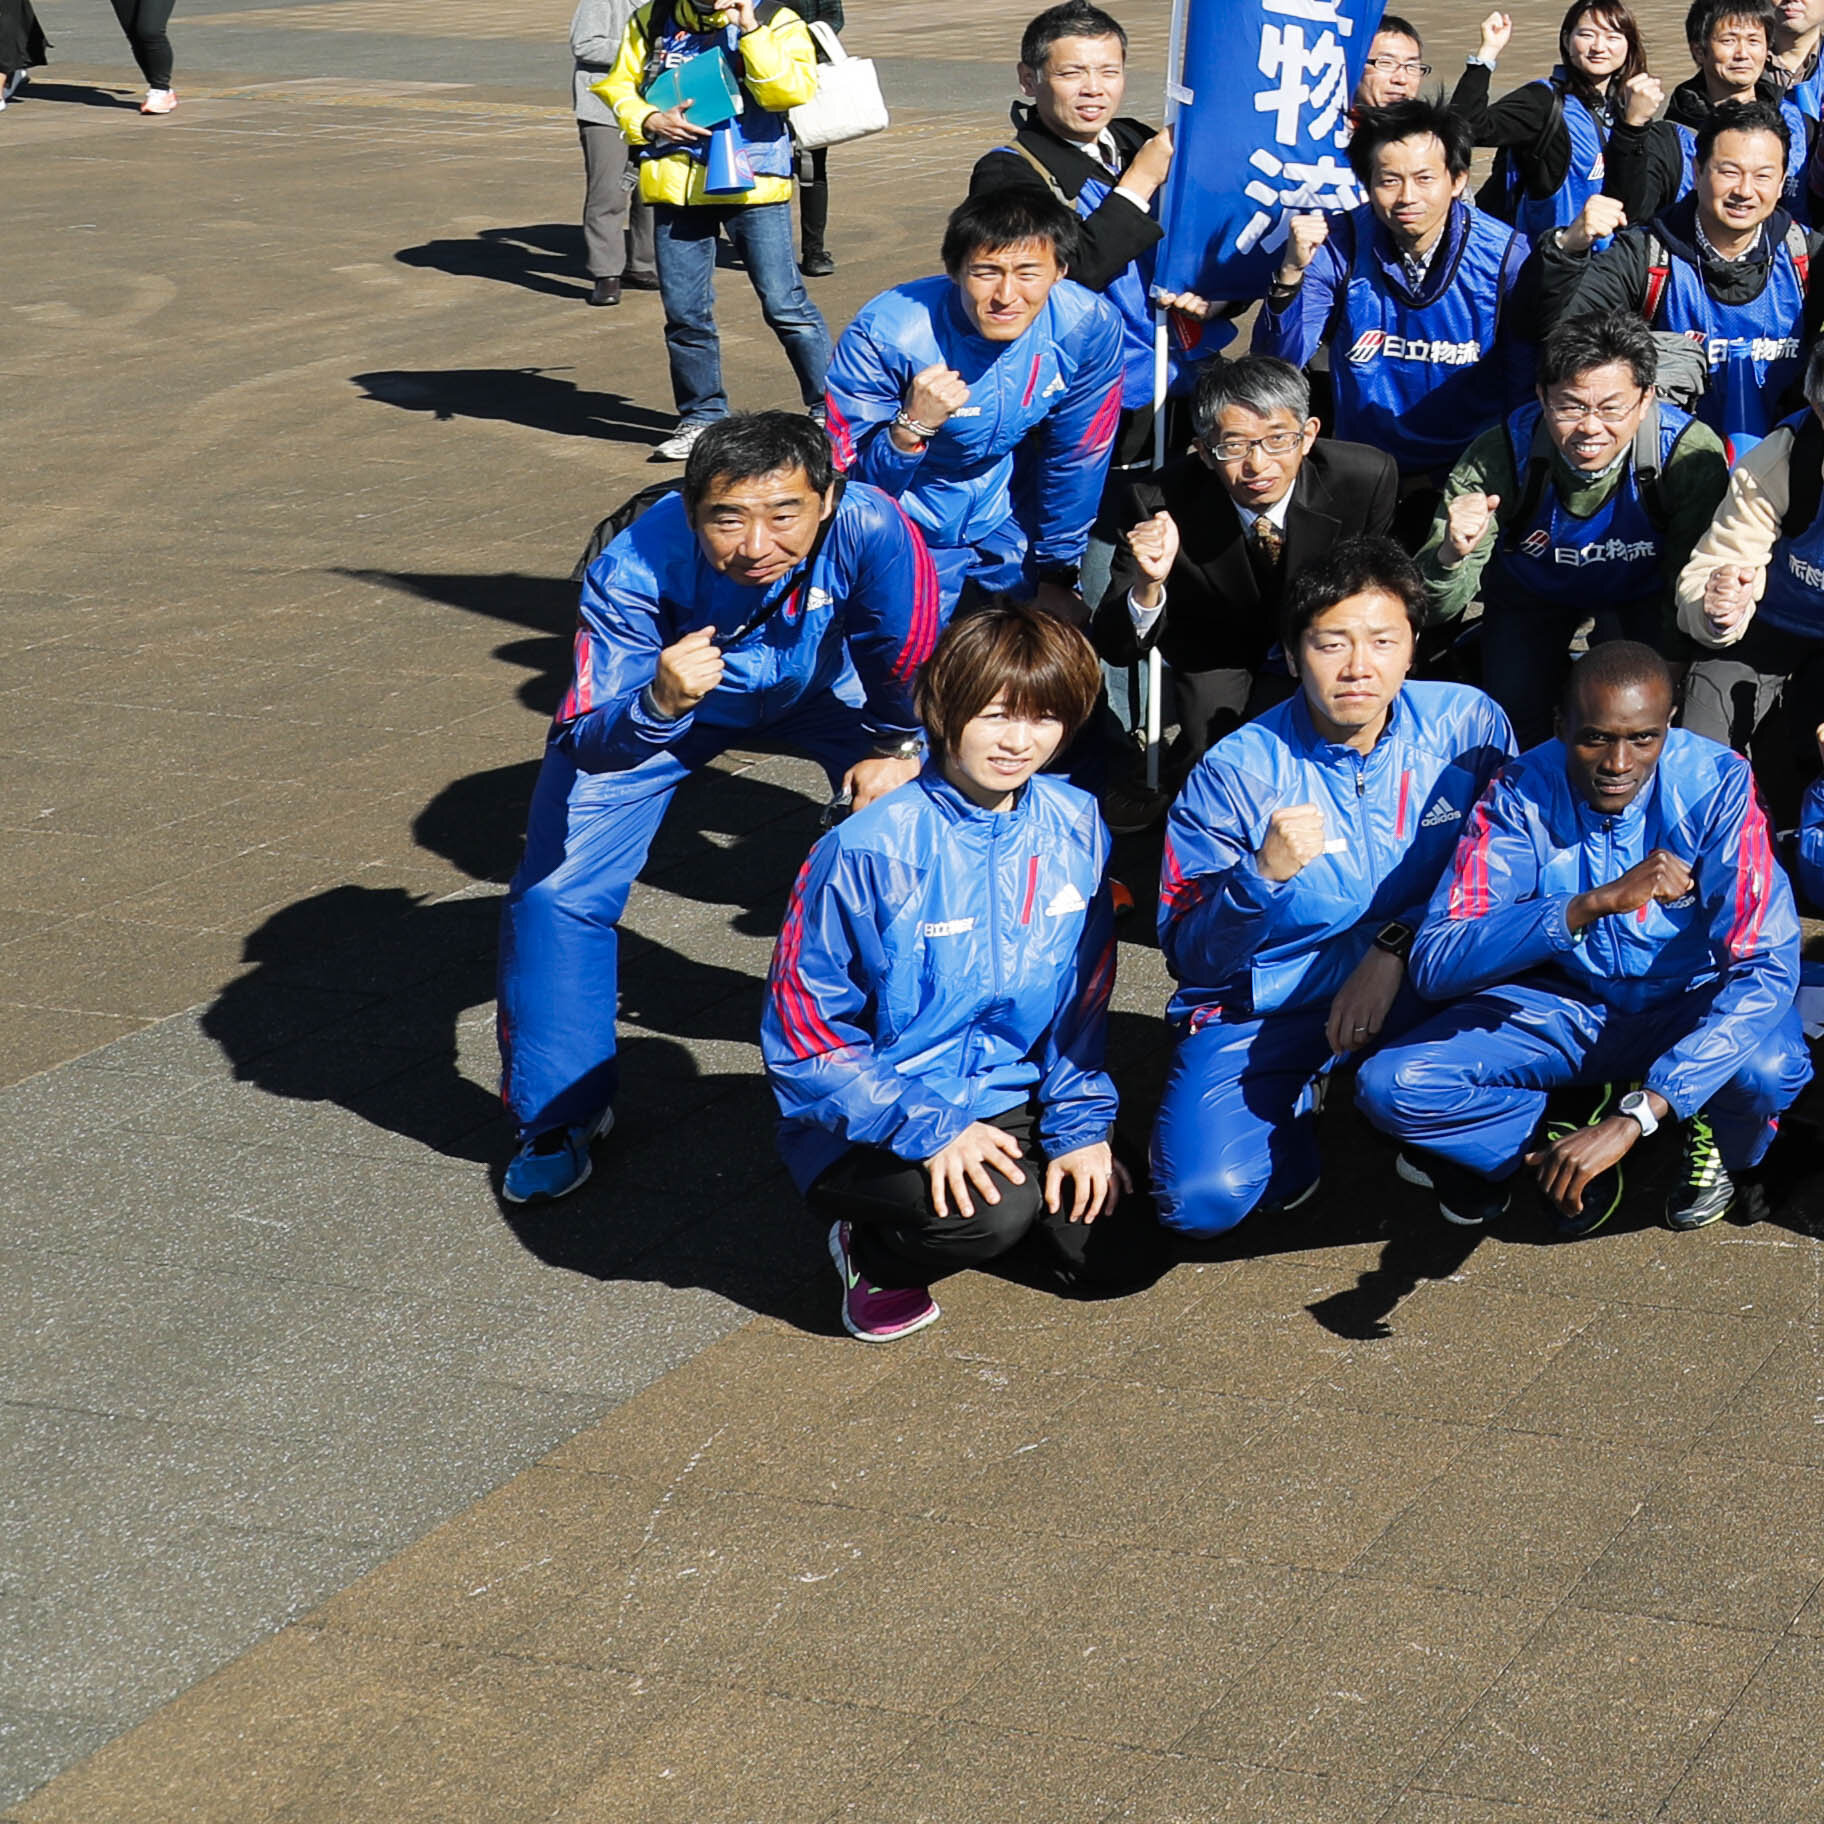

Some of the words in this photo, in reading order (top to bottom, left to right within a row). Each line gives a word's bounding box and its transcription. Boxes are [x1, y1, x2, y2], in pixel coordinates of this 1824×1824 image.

[1384, 338, 1480, 366] 日立物流
[1555, 539, 1656, 567] 日立物流
[1421, 810, 1462, 827] adidas
